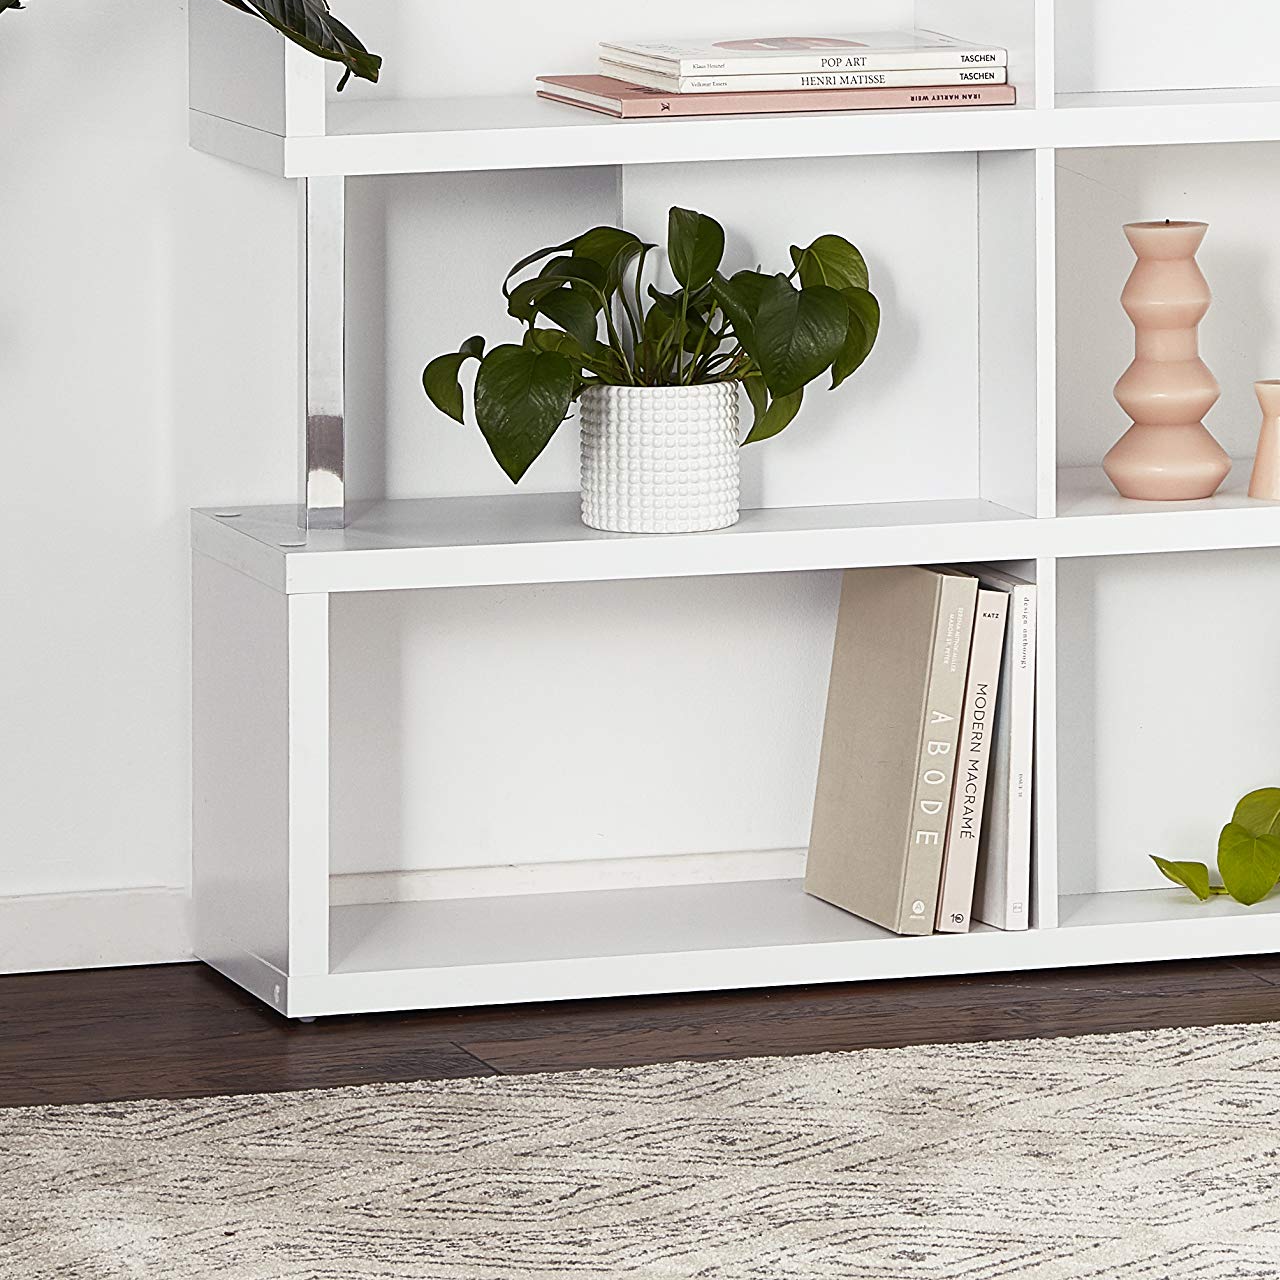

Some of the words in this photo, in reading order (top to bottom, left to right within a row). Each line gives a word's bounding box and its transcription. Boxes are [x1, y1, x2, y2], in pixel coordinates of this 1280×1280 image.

[821, 58, 842, 68] POP
[845, 57, 867, 67] ART
[960, 54, 996, 63] TASCHEN
[801, 75, 836, 86] HENRI
[839, 74, 886, 85] MATISSE
[959, 72, 995, 81] TASCHEN
[1022, 596, 1030, 625] design
[970, 683, 988, 753] MODERN
[915, 710, 954, 845] ABODE
[959, 759, 979, 839] MACRAMÉ
